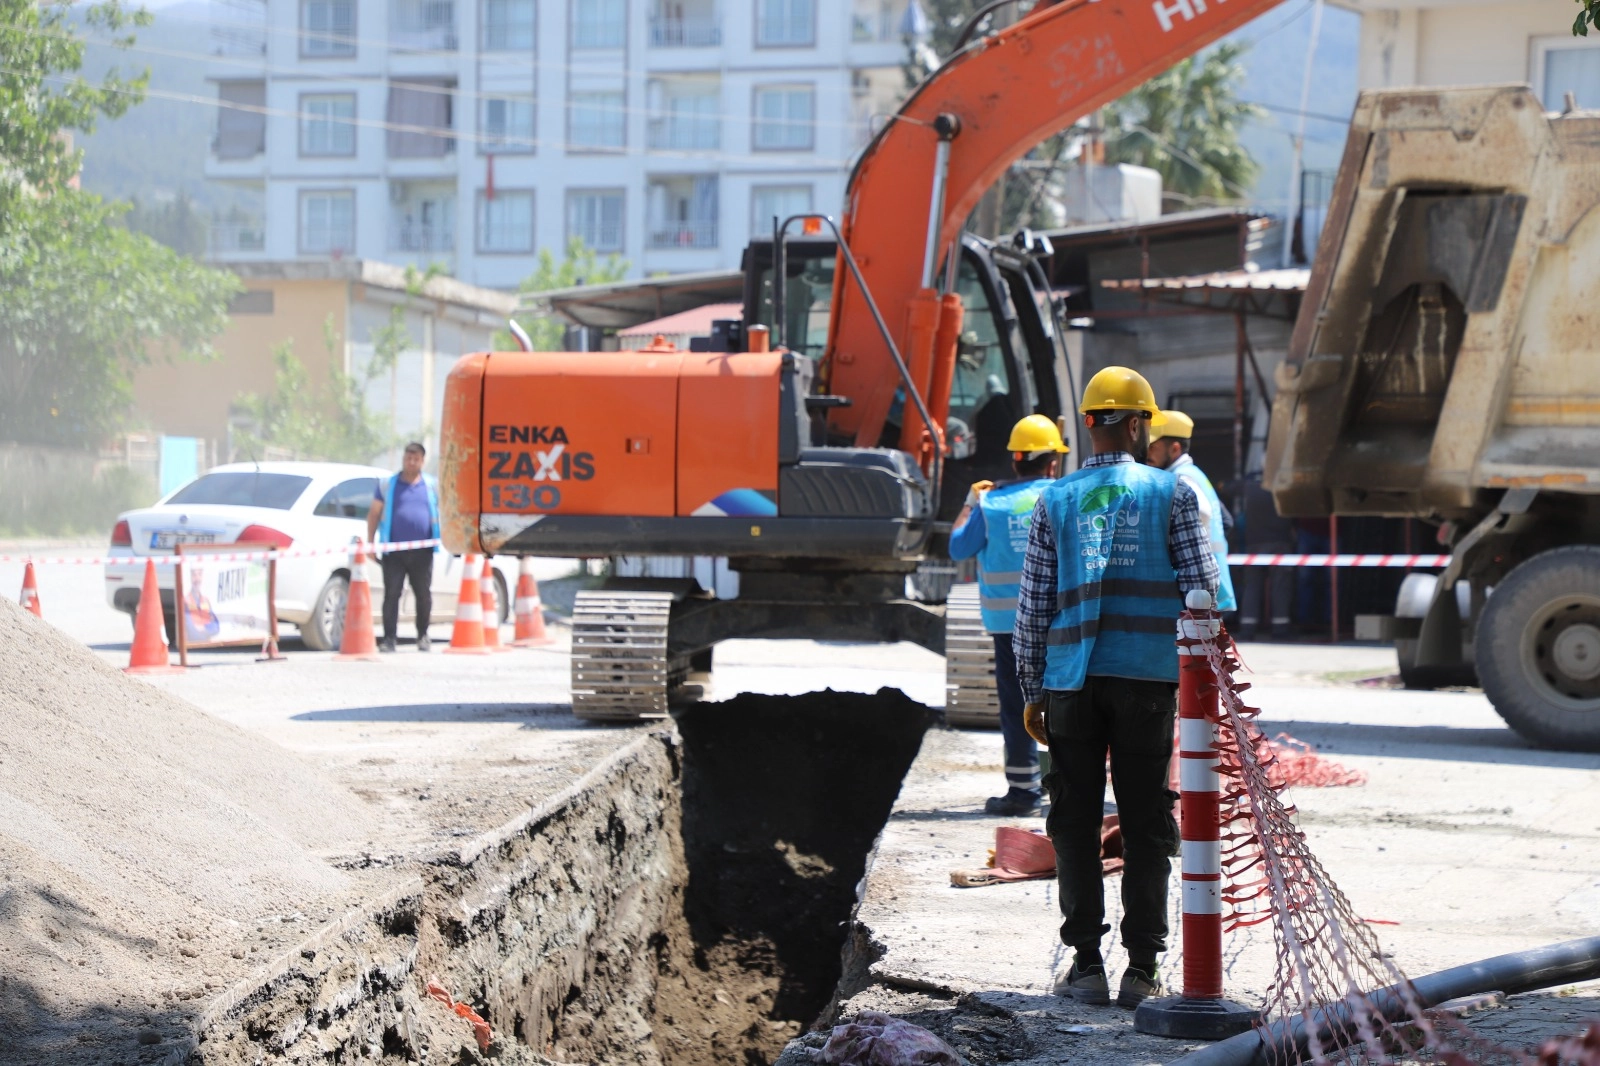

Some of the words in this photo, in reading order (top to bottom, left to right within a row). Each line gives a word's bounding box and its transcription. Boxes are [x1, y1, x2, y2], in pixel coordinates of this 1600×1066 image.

[489, 425, 569, 444] ENKA
[488, 444, 595, 481] ZAXIS
[488, 484, 561, 509] 130
[1111, 543, 1139, 552] TYAPI
[217, 567, 247, 603] HATAY
